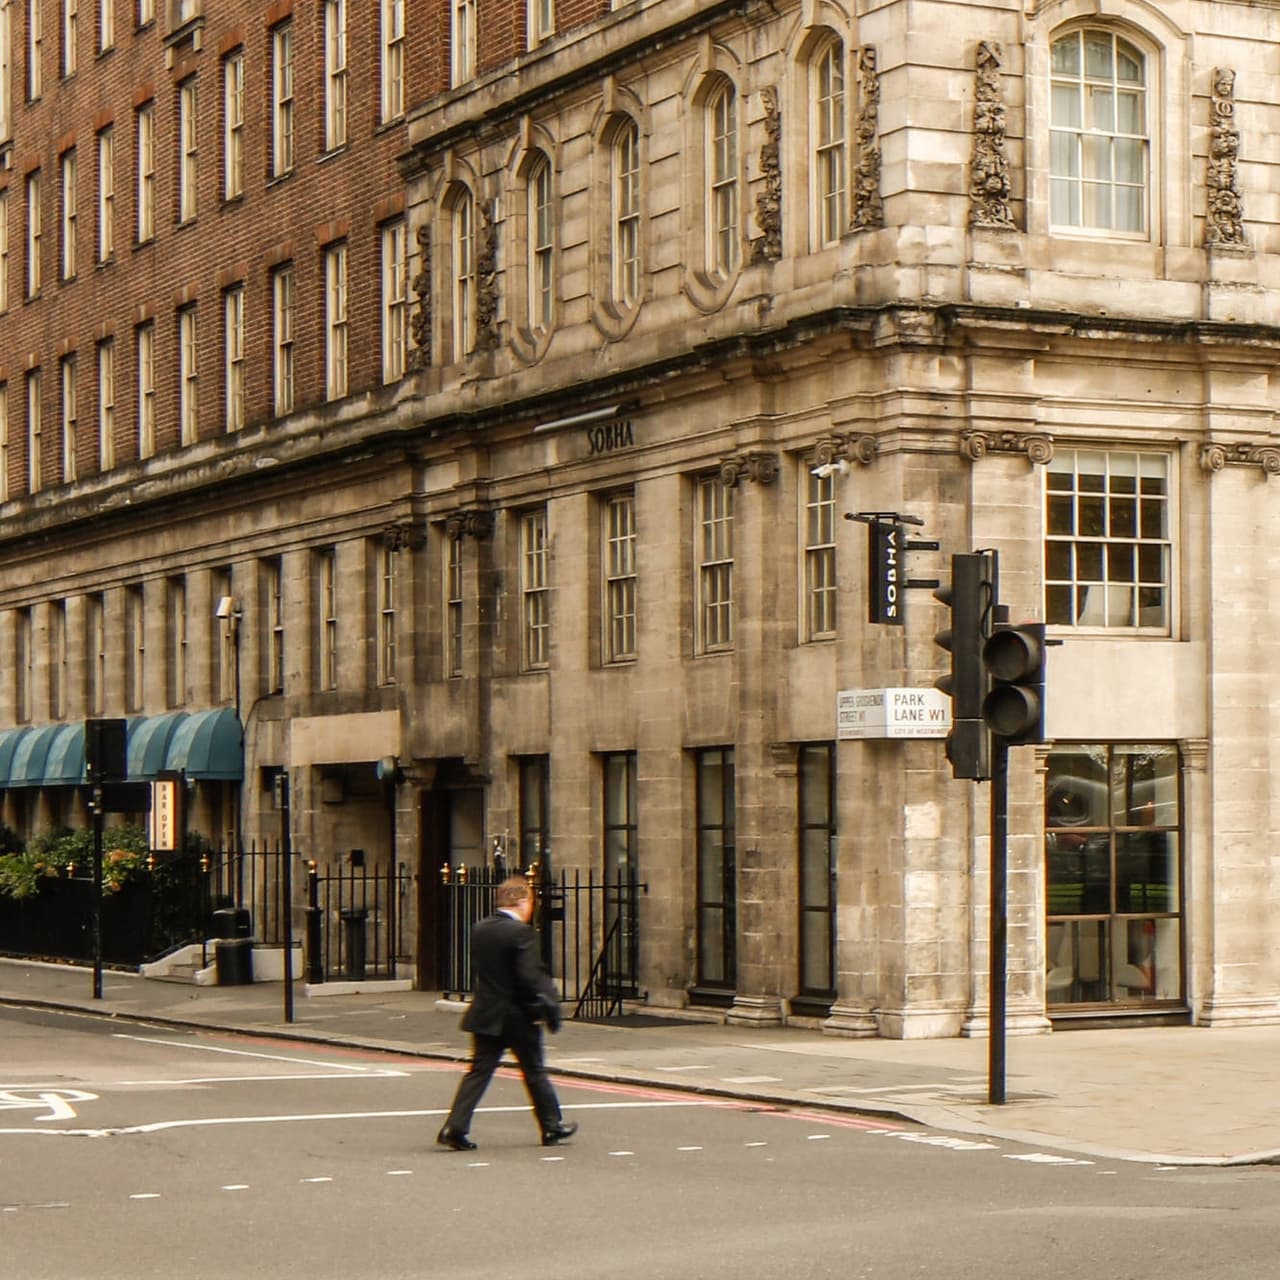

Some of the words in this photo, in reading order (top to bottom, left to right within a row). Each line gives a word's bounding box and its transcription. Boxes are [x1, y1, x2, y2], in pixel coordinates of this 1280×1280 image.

[587, 421, 634, 455] SOBHA
[887, 531, 897, 617] SOBHA
[894, 694, 925, 706] PARK
[894, 709, 924, 721] LANE
[929, 709, 945, 721] W1
